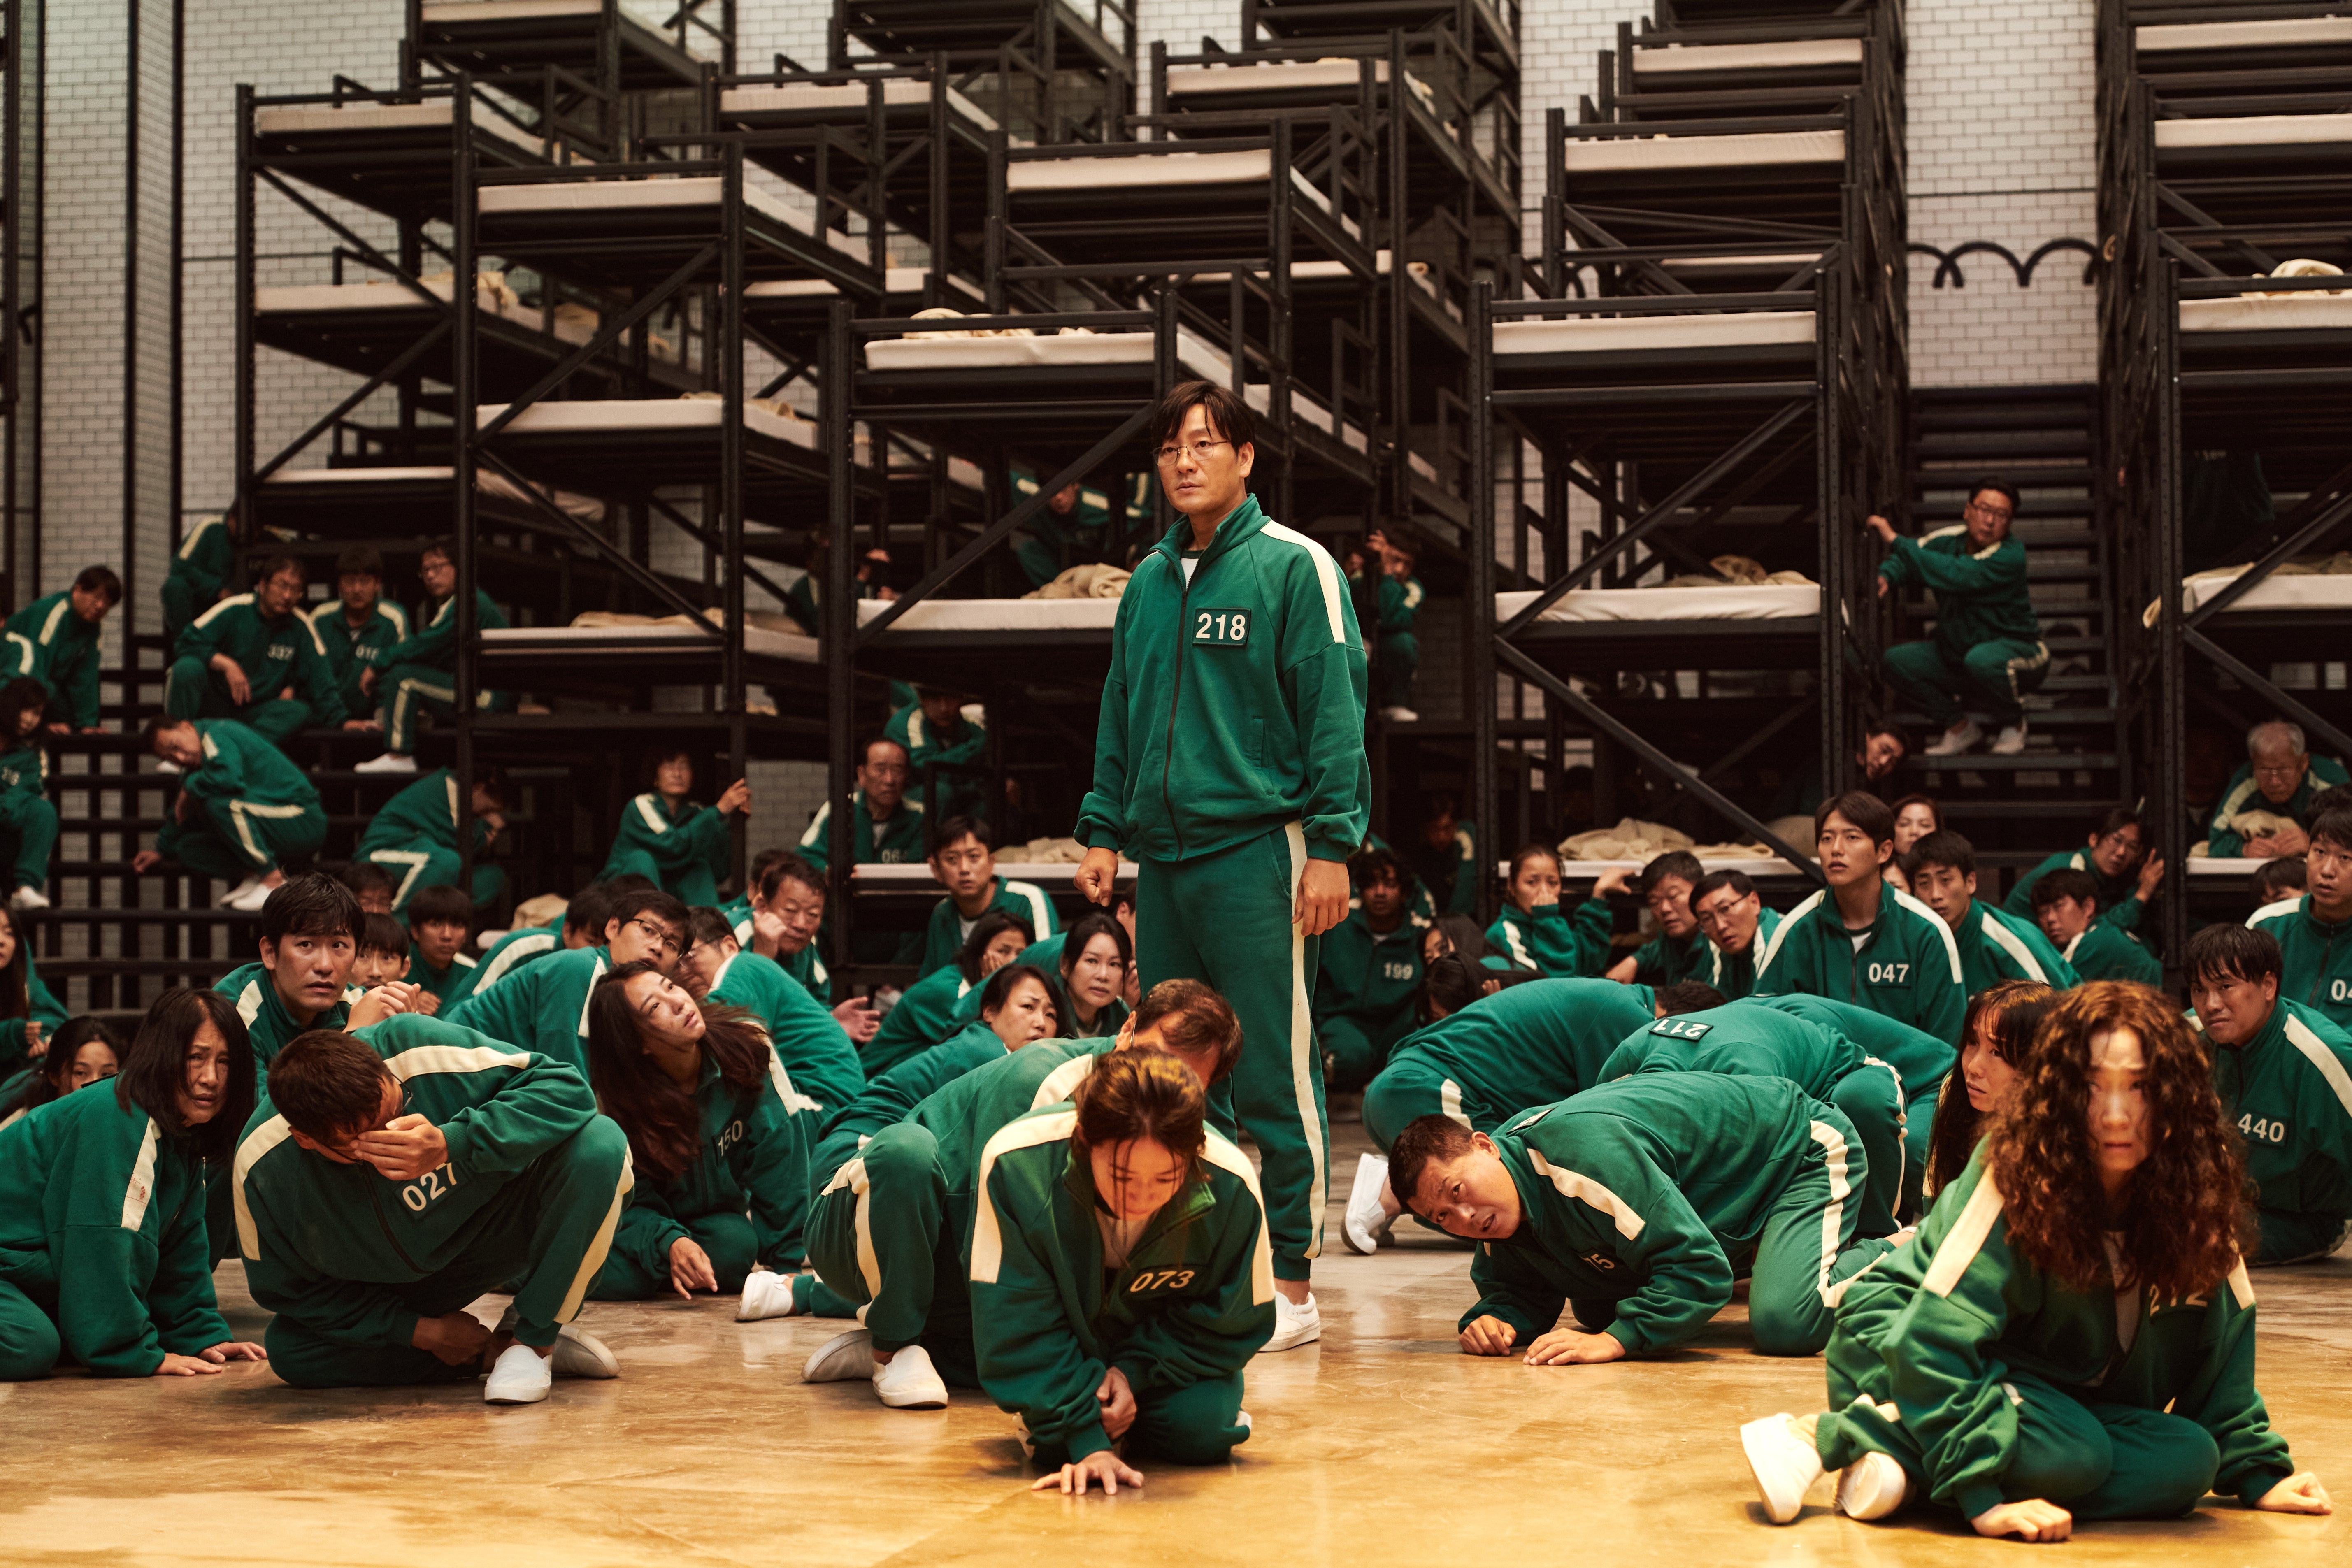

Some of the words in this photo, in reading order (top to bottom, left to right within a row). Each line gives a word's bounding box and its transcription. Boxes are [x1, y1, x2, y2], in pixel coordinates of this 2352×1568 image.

[1195, 613, 1246, 641] 218
[1383, 962, 1413, 980] 199
[1869, 962, 1910, 983] 047
[1653, 1018, 1708, 1038] 211
[718, 1120, 743, 1157] 150
[2238, 1113, 2285, 1143] 440
[402, 1161, 457, 1212] 027
[1130, 1270, 1195, 1293] 073
